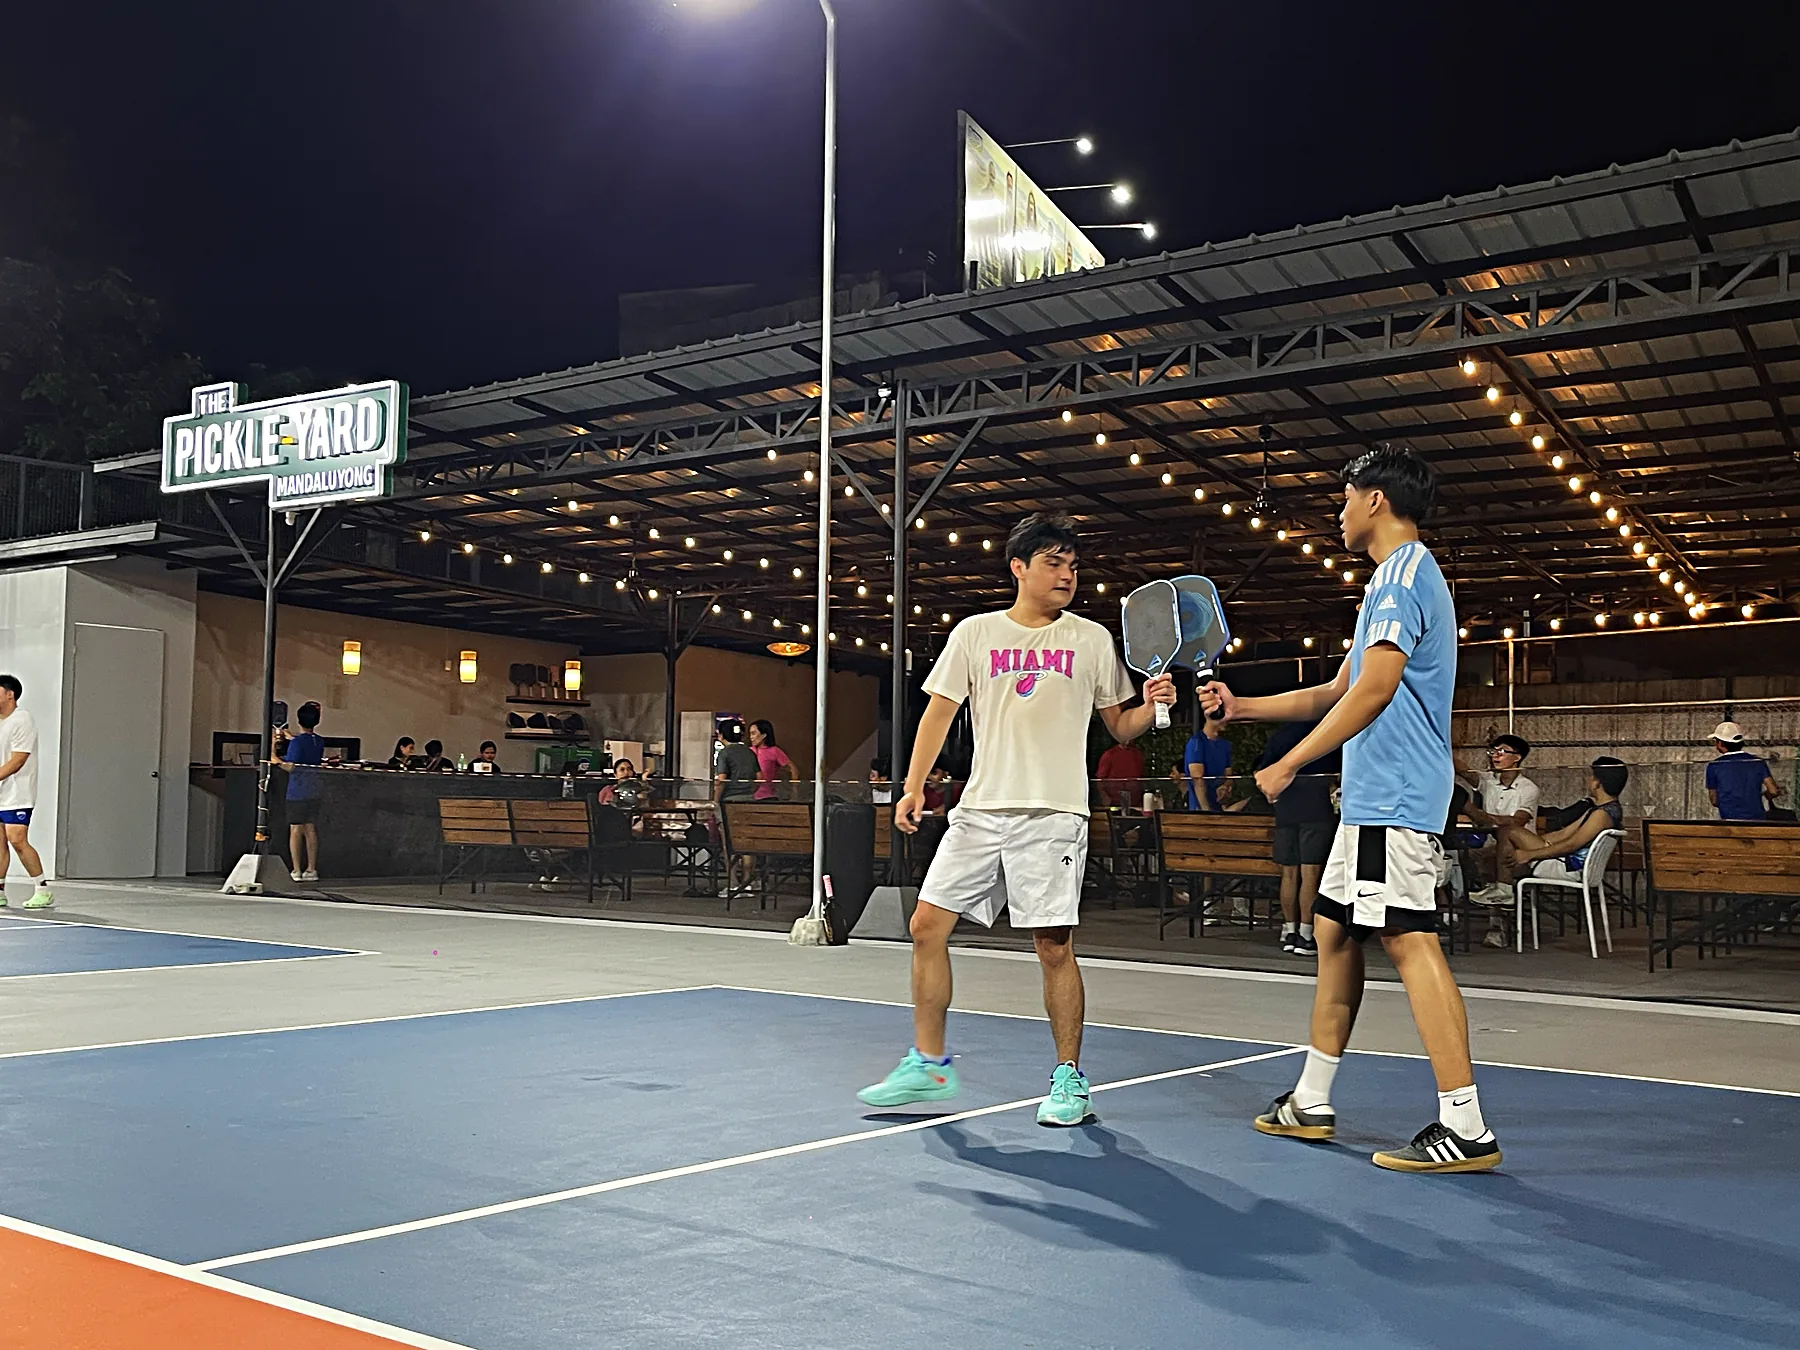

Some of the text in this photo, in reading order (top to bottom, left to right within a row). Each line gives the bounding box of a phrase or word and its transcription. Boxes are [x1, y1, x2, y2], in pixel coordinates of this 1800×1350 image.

[199, 391, 228, 415] THE
[276, 464, 374, 497] MANDALUYONG
[990, 649, 1075, 679] MIAMI
